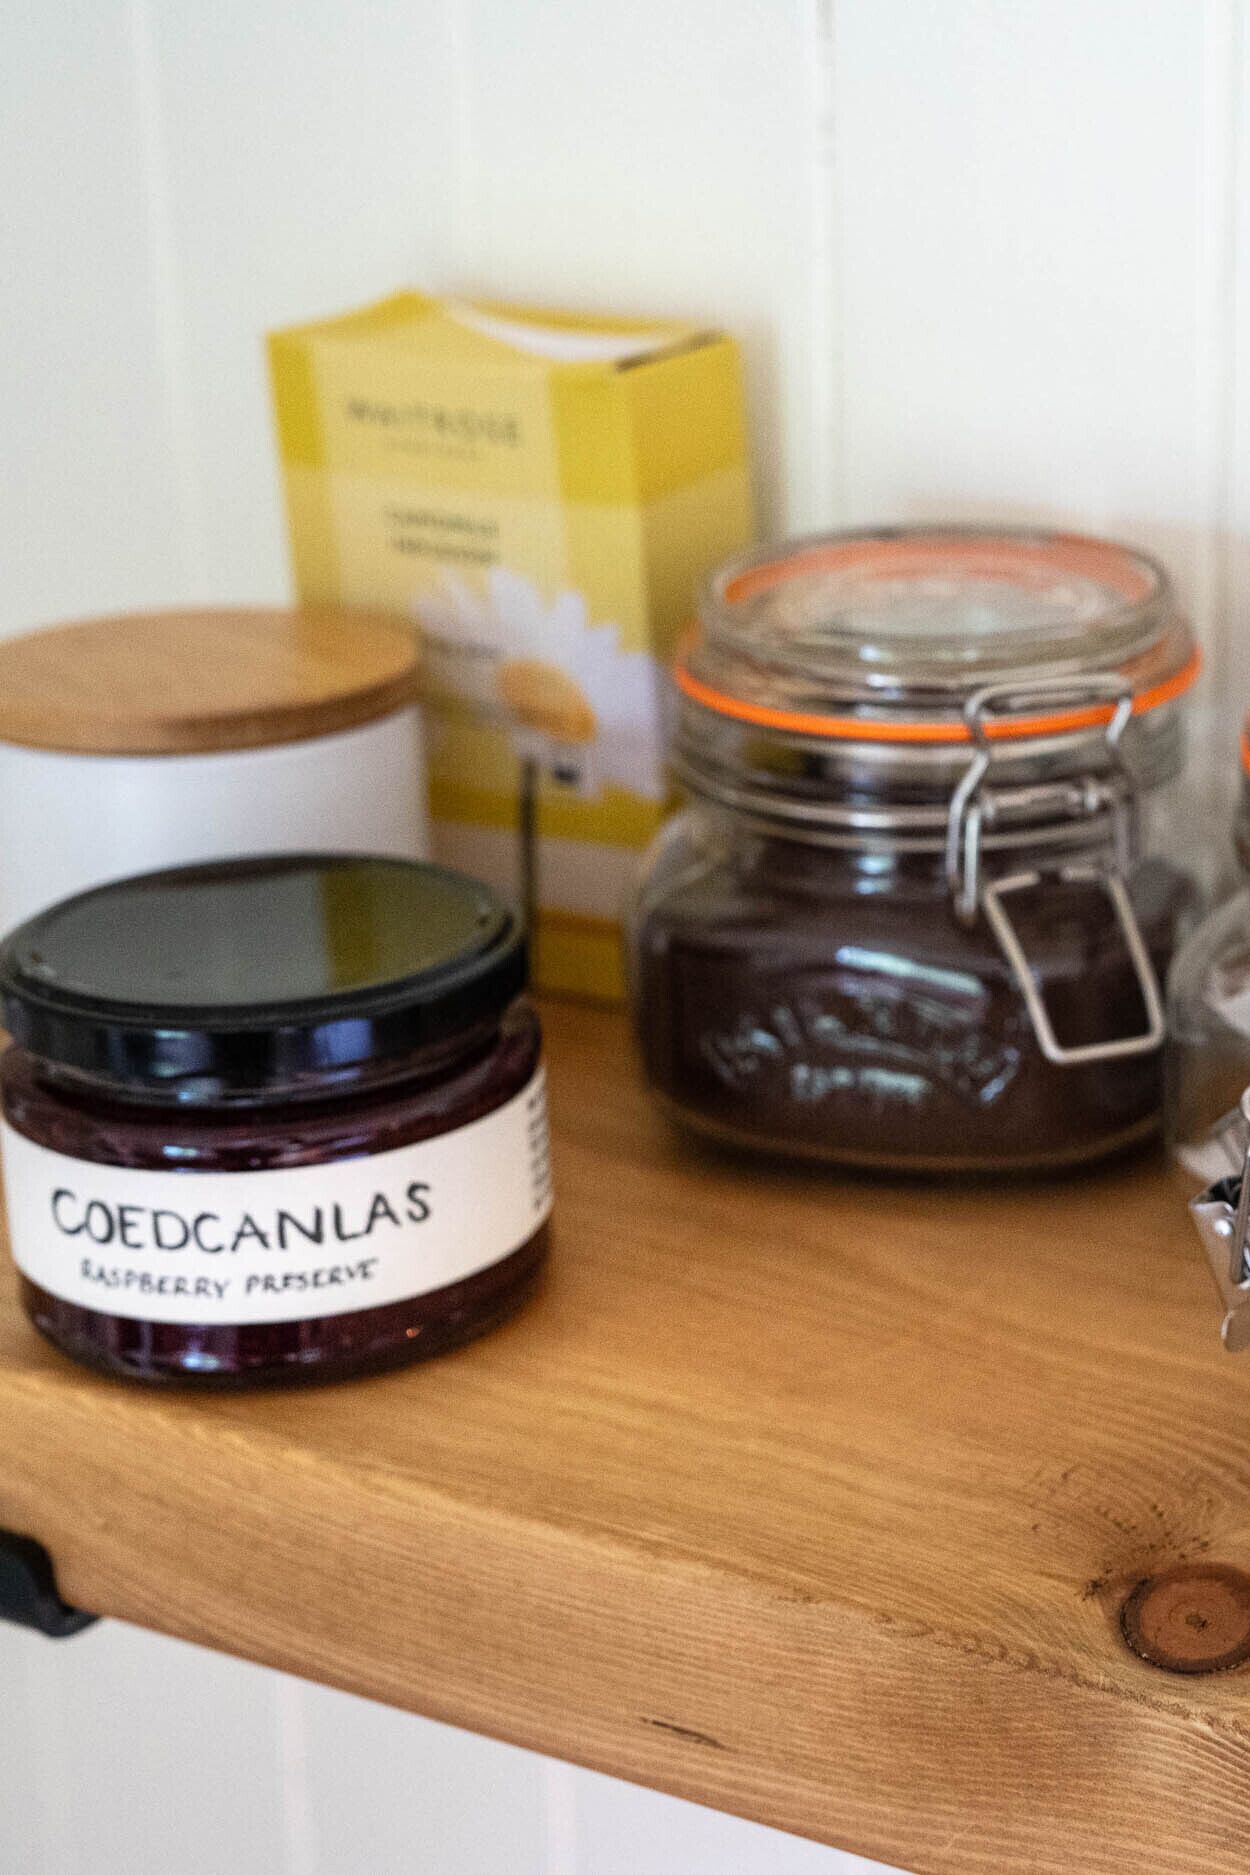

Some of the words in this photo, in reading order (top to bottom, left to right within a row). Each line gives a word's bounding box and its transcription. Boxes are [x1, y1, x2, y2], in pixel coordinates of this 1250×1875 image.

[51, 1181, 432, 1254] COEDCANLAS
[80, 1257, 231, 1299] RASPBERRY
[244, 1257, 379, 1296] PRESERVE
